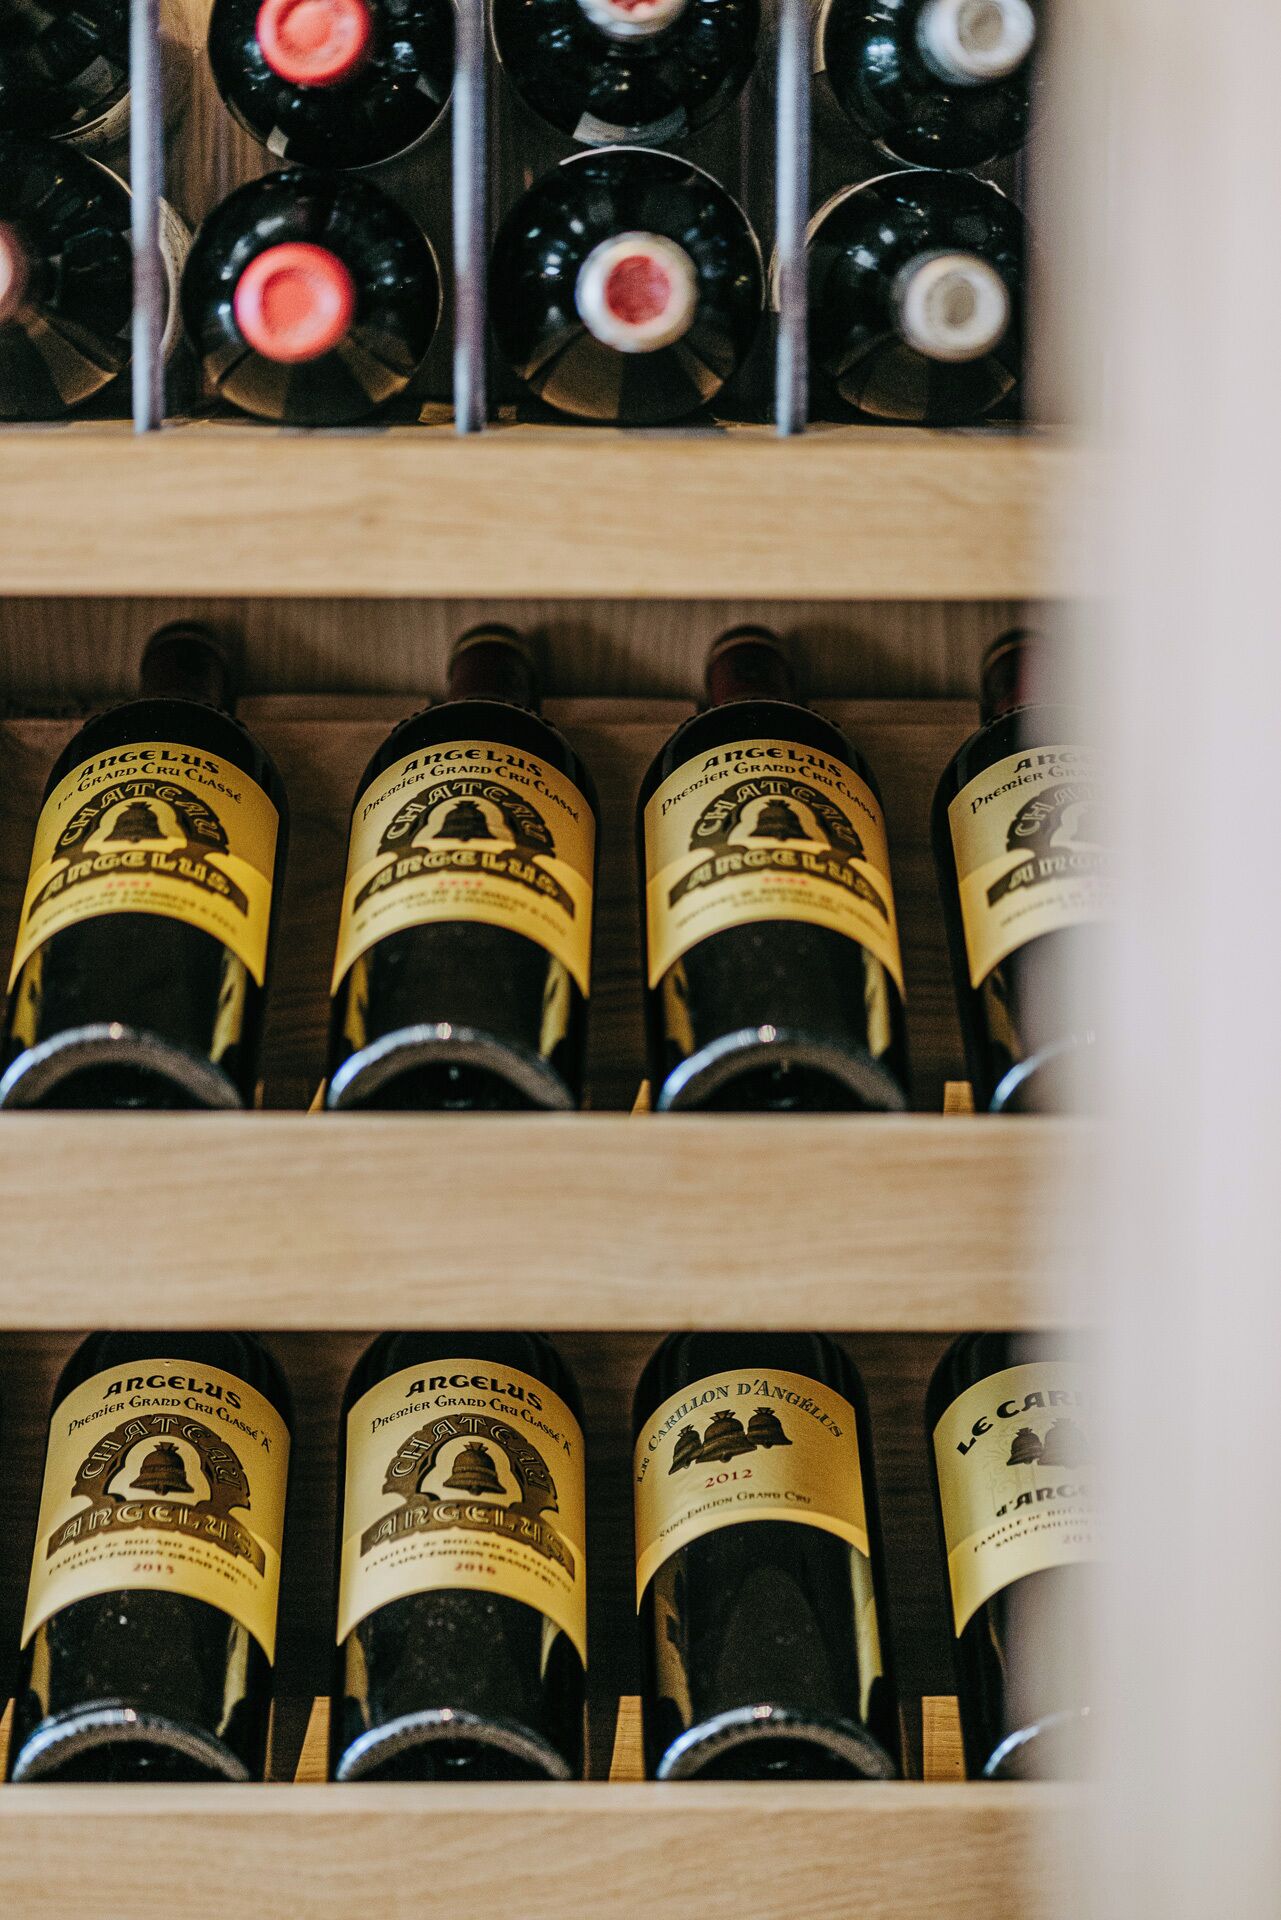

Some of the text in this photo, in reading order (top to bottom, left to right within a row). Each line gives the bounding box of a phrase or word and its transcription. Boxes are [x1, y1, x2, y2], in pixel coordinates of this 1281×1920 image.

[78, 750, 220, 782] ANGELUS
[78, 767, 137, 793] GRAND
[141, 762, 181, 776] CRU
[401, 749, 543, 778] ANGELUS
[701, 747, 842, 778] ANGELUS
[362, 772, 425, 822] PREMIER
[430, 764, 492, 777] GRAND
[495, 766, 530, 786] CRU
[387, 781, 548, 843] CHATEAU
[661, 771, 729, 816] PREMIER
[733, 762, 796, 775] GRAND
[798, 766, 833, 786] CRU
[971, 772, 1043, 814] PREMIER
[60, 782, 221, 846] CHATEAU
[696, 780, 857, 846] CHATEAU
[42, 851, 232, 901] ANGELUS
[369, 851, 558, 897] ANGELUS
[686, 850, 875, 897] ANGELUS
[103, 1375, 242, 1410] ANGELUS
[405, 1375, 543, 1411] ANGELUS
[68, 1401, 125, 1435] PREMIER
[128, 1395, 181, 1408] GRAND
[184, 1397, 213, 1415] CRU
[216, 1407, 258, 1441] CLASSÉ
[371, 1401, 431, 1434] PREMIER
[434, 1395, 487, 1408] GRAND
[489, 1397, 518, 1415] CRU
[521, 1409, 562, 1443] CLASSÉ
[648, 1385, 730, 1451] CARILLON
[956, 1416, 994, 1456] LE
[81, 1415, 241, 1490] CHATEAU
[391, 1416, 548, 1492] CHATEAU
[704, 1469, 754, 1488] 2012
[737, 1491, 781, 1501] GRAND
[784, 1491, 812, 1504] CRU
[59, 1503, 253, 1562] ANGELUS
[374, 1503, 567, 1562] ANGELUS
